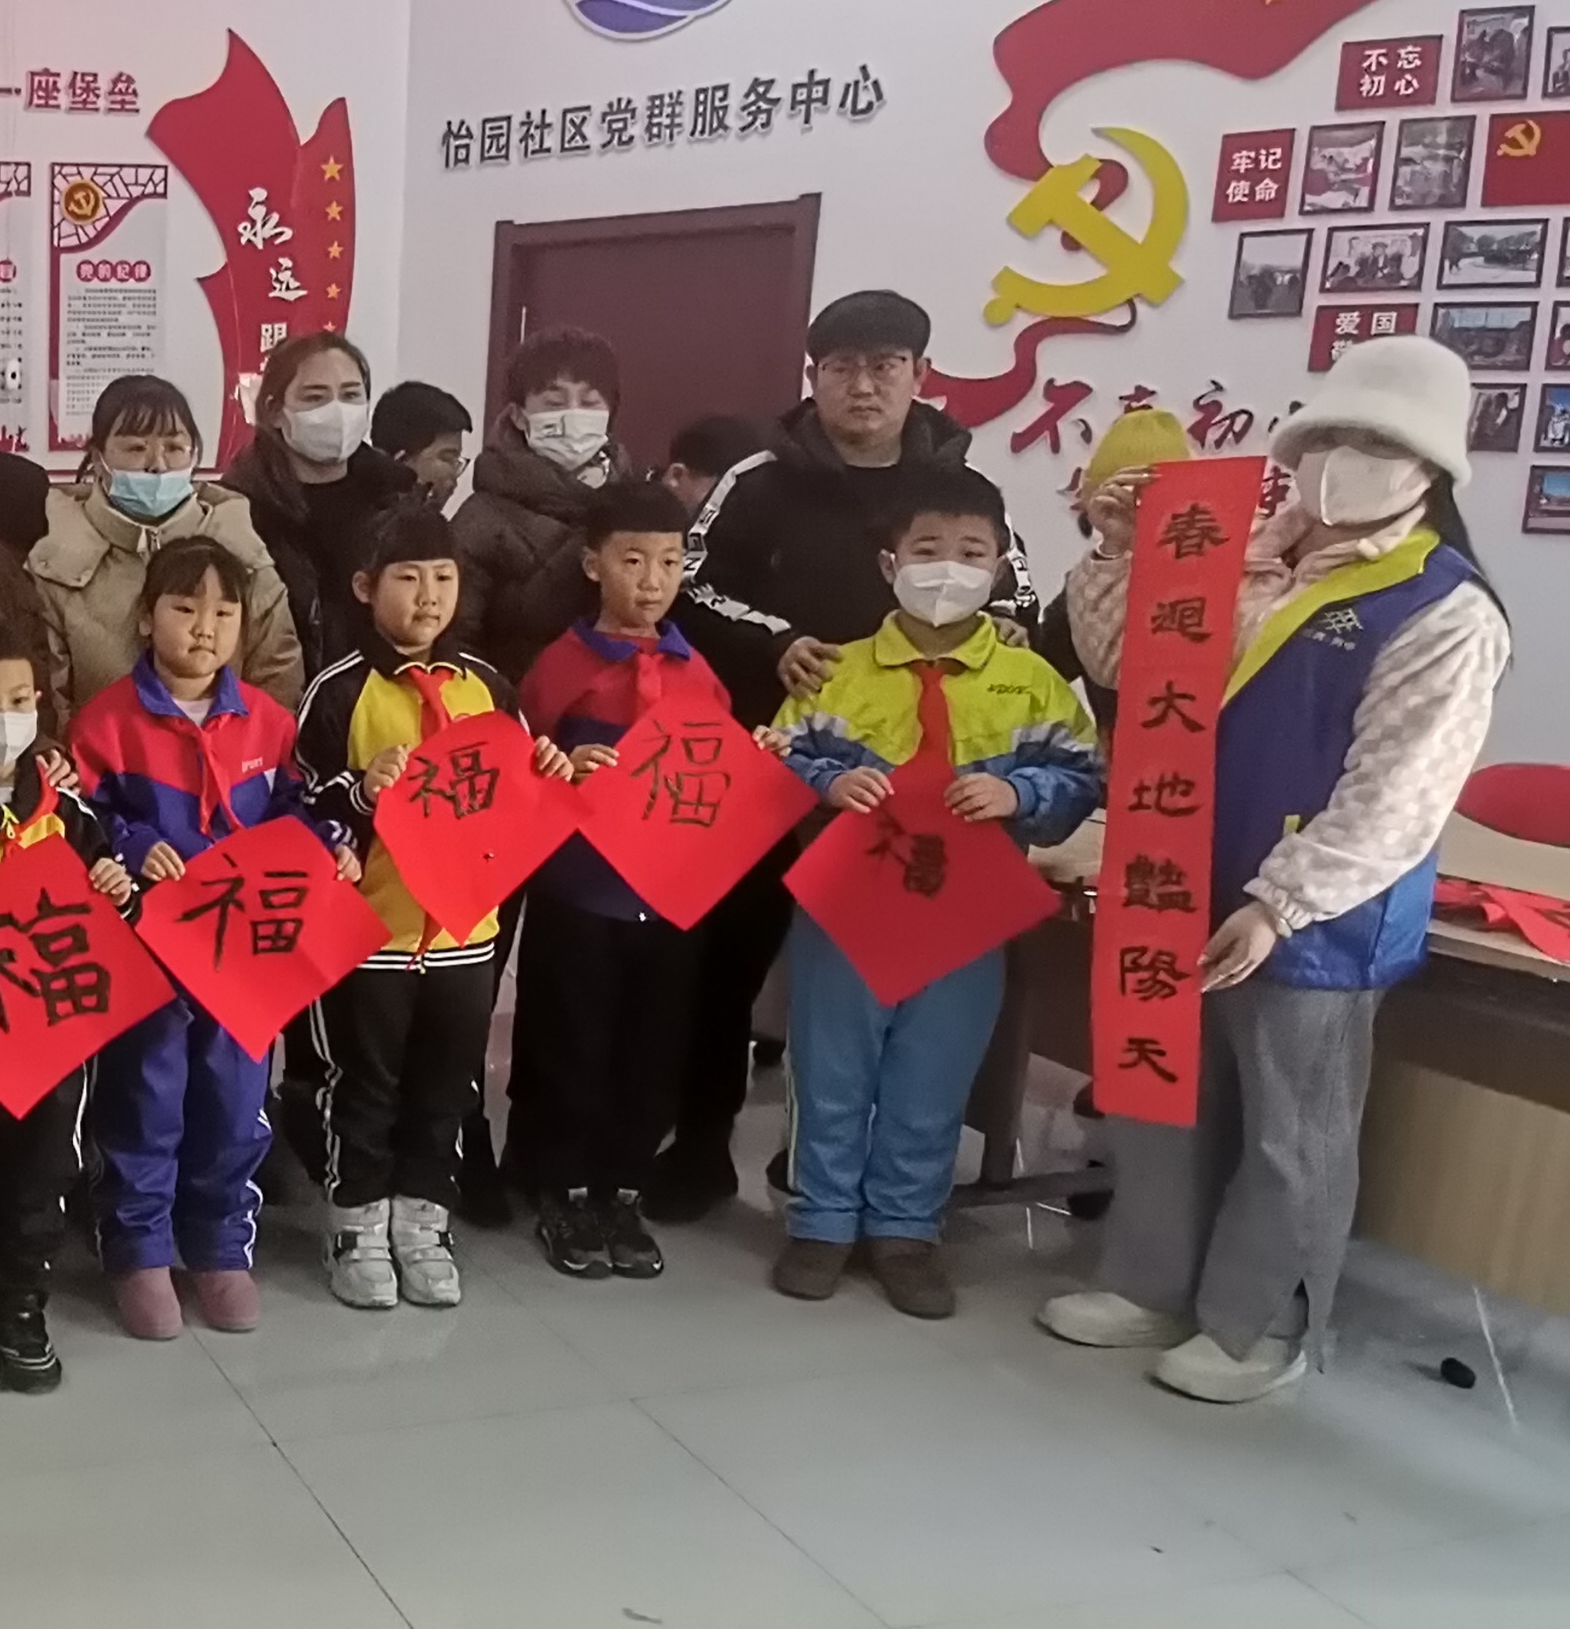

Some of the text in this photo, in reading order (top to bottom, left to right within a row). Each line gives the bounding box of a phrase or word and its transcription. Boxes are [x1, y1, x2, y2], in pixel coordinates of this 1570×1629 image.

[1362, 45, 1423, 71] 不忘
[1359, 74, 1421, 98] 初心
[440, 63, 887, 169] 怡园社区党群服务中心
[1231, 147, 1283, 174] 牢记
[1226, 179, 1280, 204] 使命
[1334, 311, 1397, 335] 爱国
[408, 741, 500, 820] 福
[631, 719, 731, 828] 福
[173, 854, 309, 971] 福
